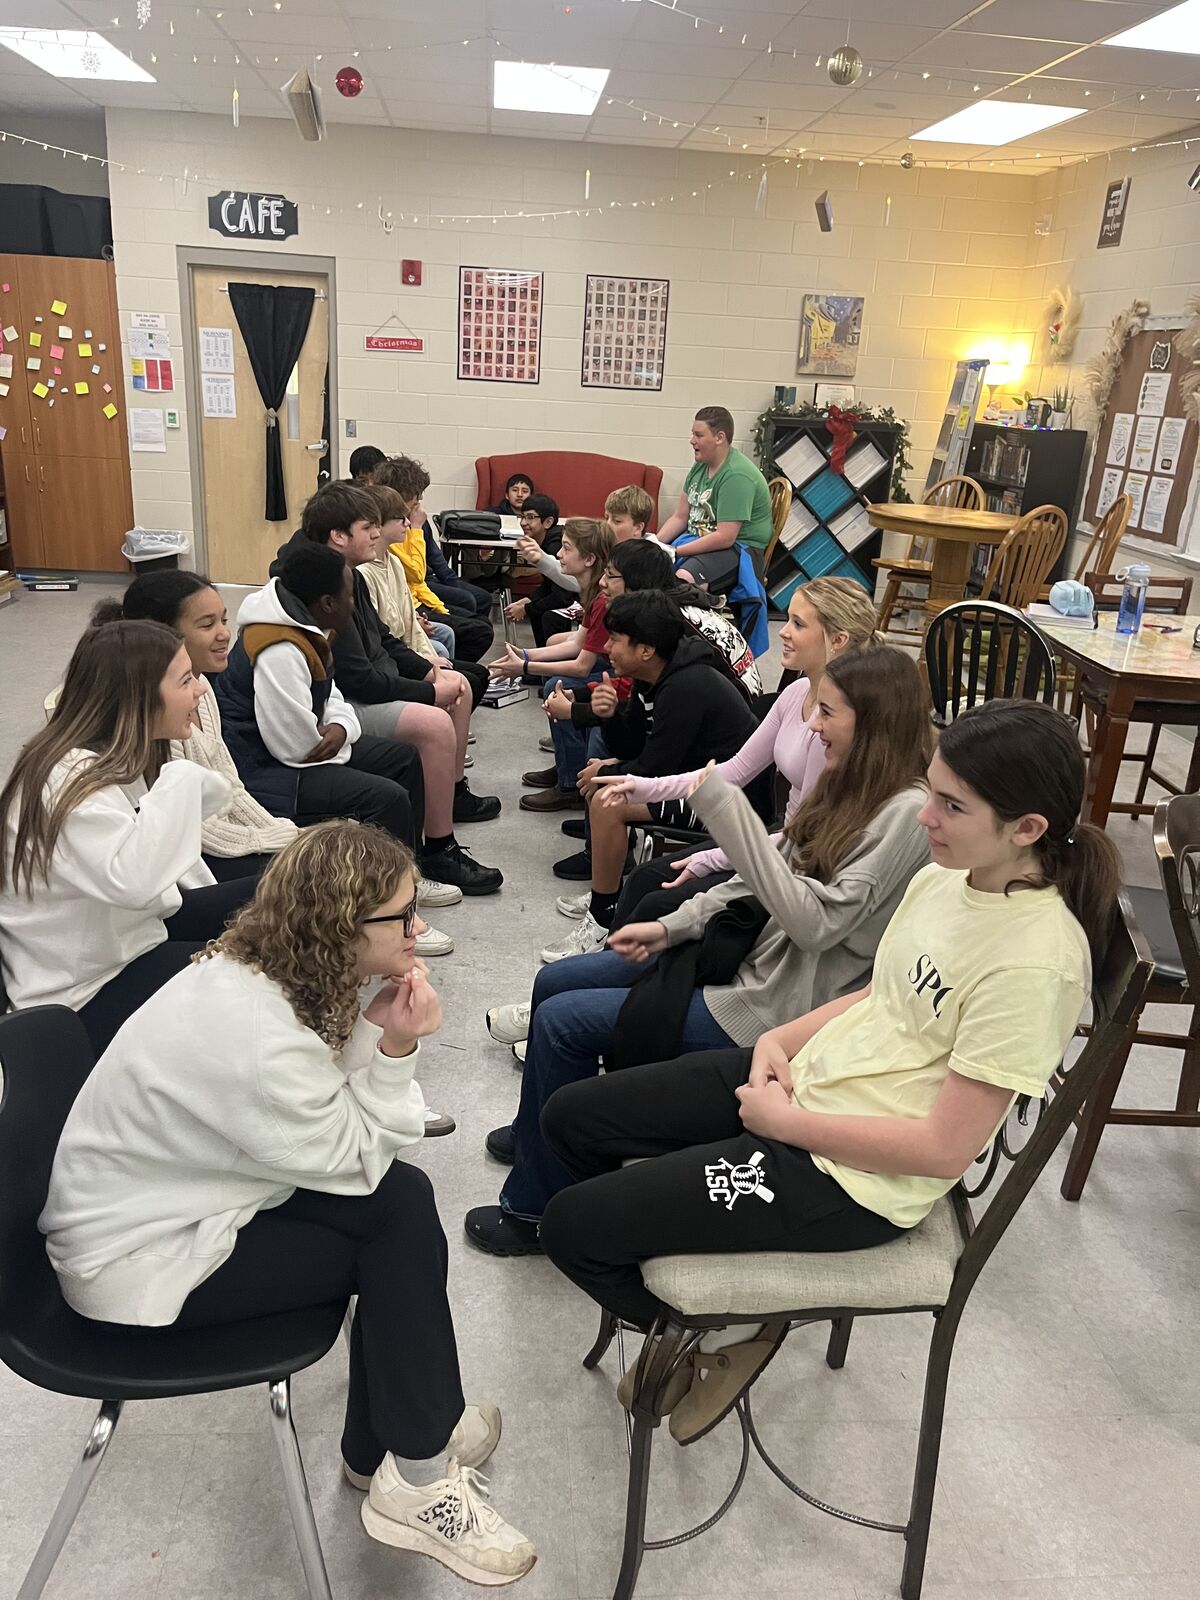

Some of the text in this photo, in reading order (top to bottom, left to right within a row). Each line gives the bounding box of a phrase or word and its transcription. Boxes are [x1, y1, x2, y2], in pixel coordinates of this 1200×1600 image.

[221, 198, 286, 235] CAFE
[370, 338, 418, 347] Christmas
[704, 1163, 732, 1202] LSC
